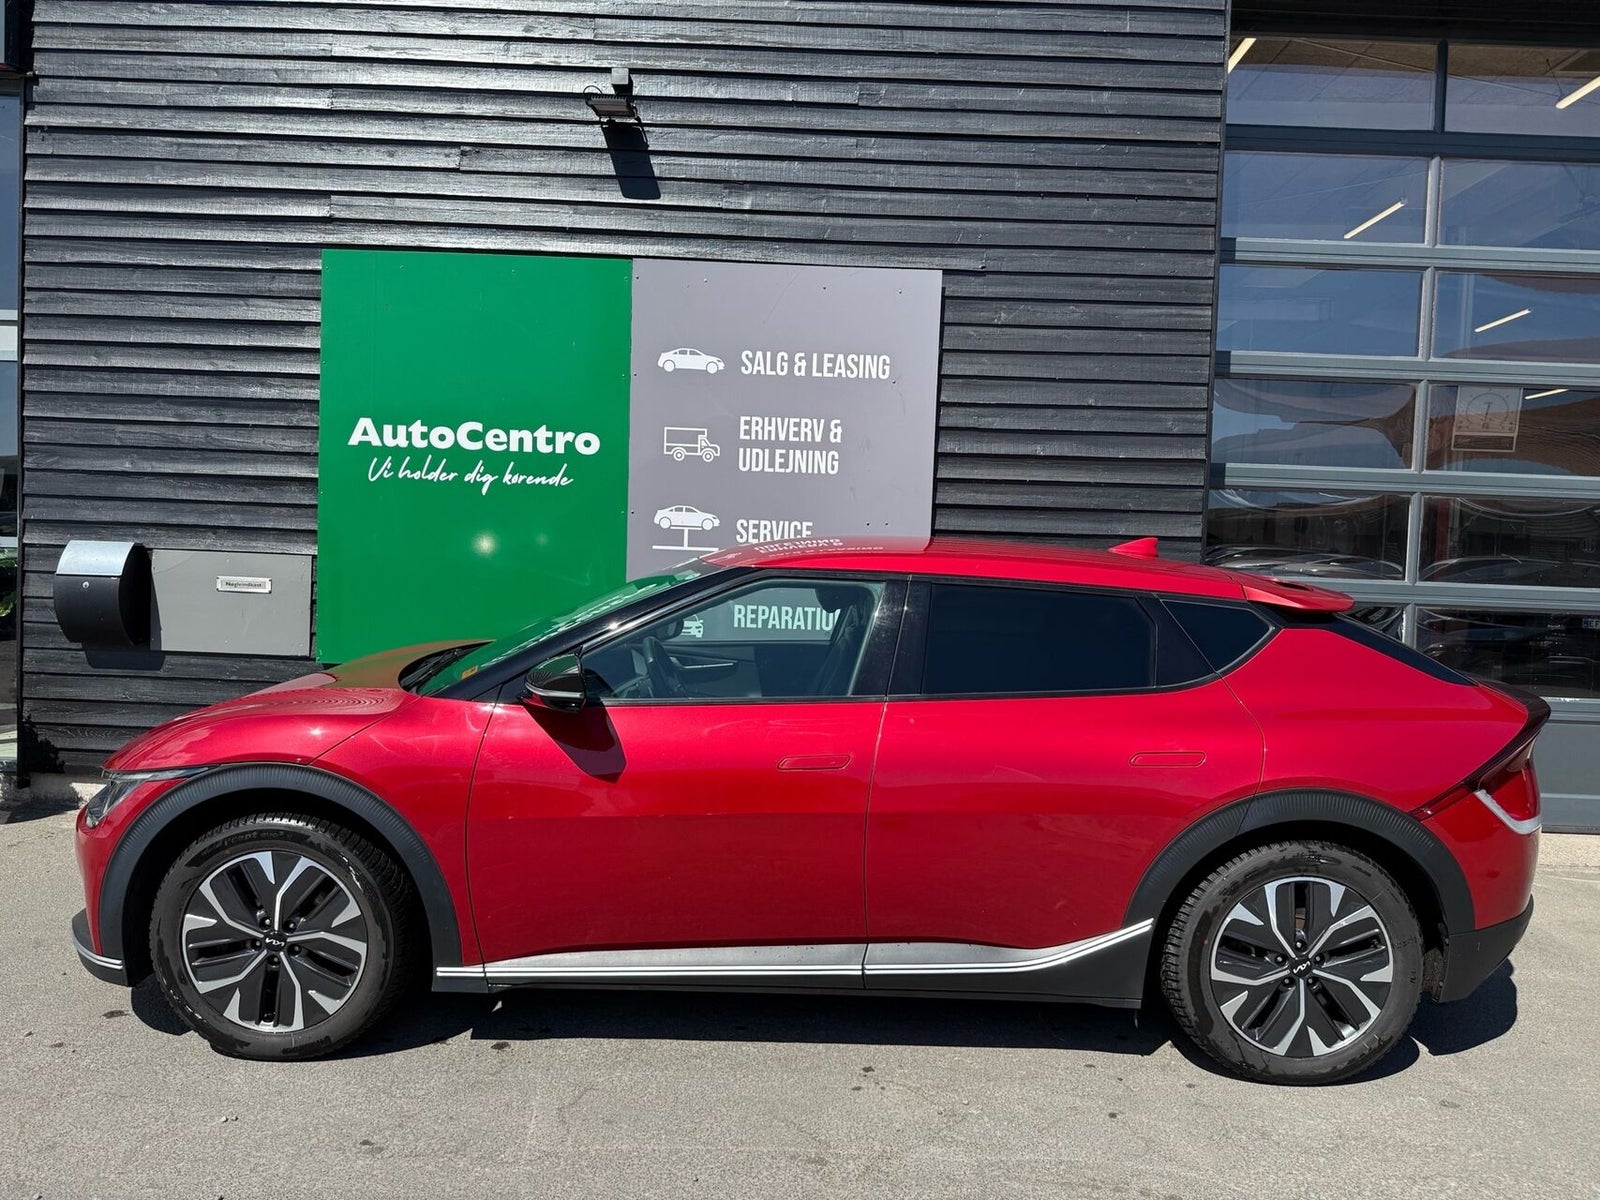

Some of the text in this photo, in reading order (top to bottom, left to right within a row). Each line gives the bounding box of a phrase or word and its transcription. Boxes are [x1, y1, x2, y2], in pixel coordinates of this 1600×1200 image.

[740, 350, 891, 379] SALG & LEASING
[347, 417, 601, 456] AutoCentro
[739, 415, 842, 443] ERHVERV &
[368, 456, 394, 482] Vi
[398, 454, 458, 481] holder
[463, 459, 499, 495] dig
[738, 448, 839, 475] UDLEJNING
[736, 519, 813, 543] SERVICE
